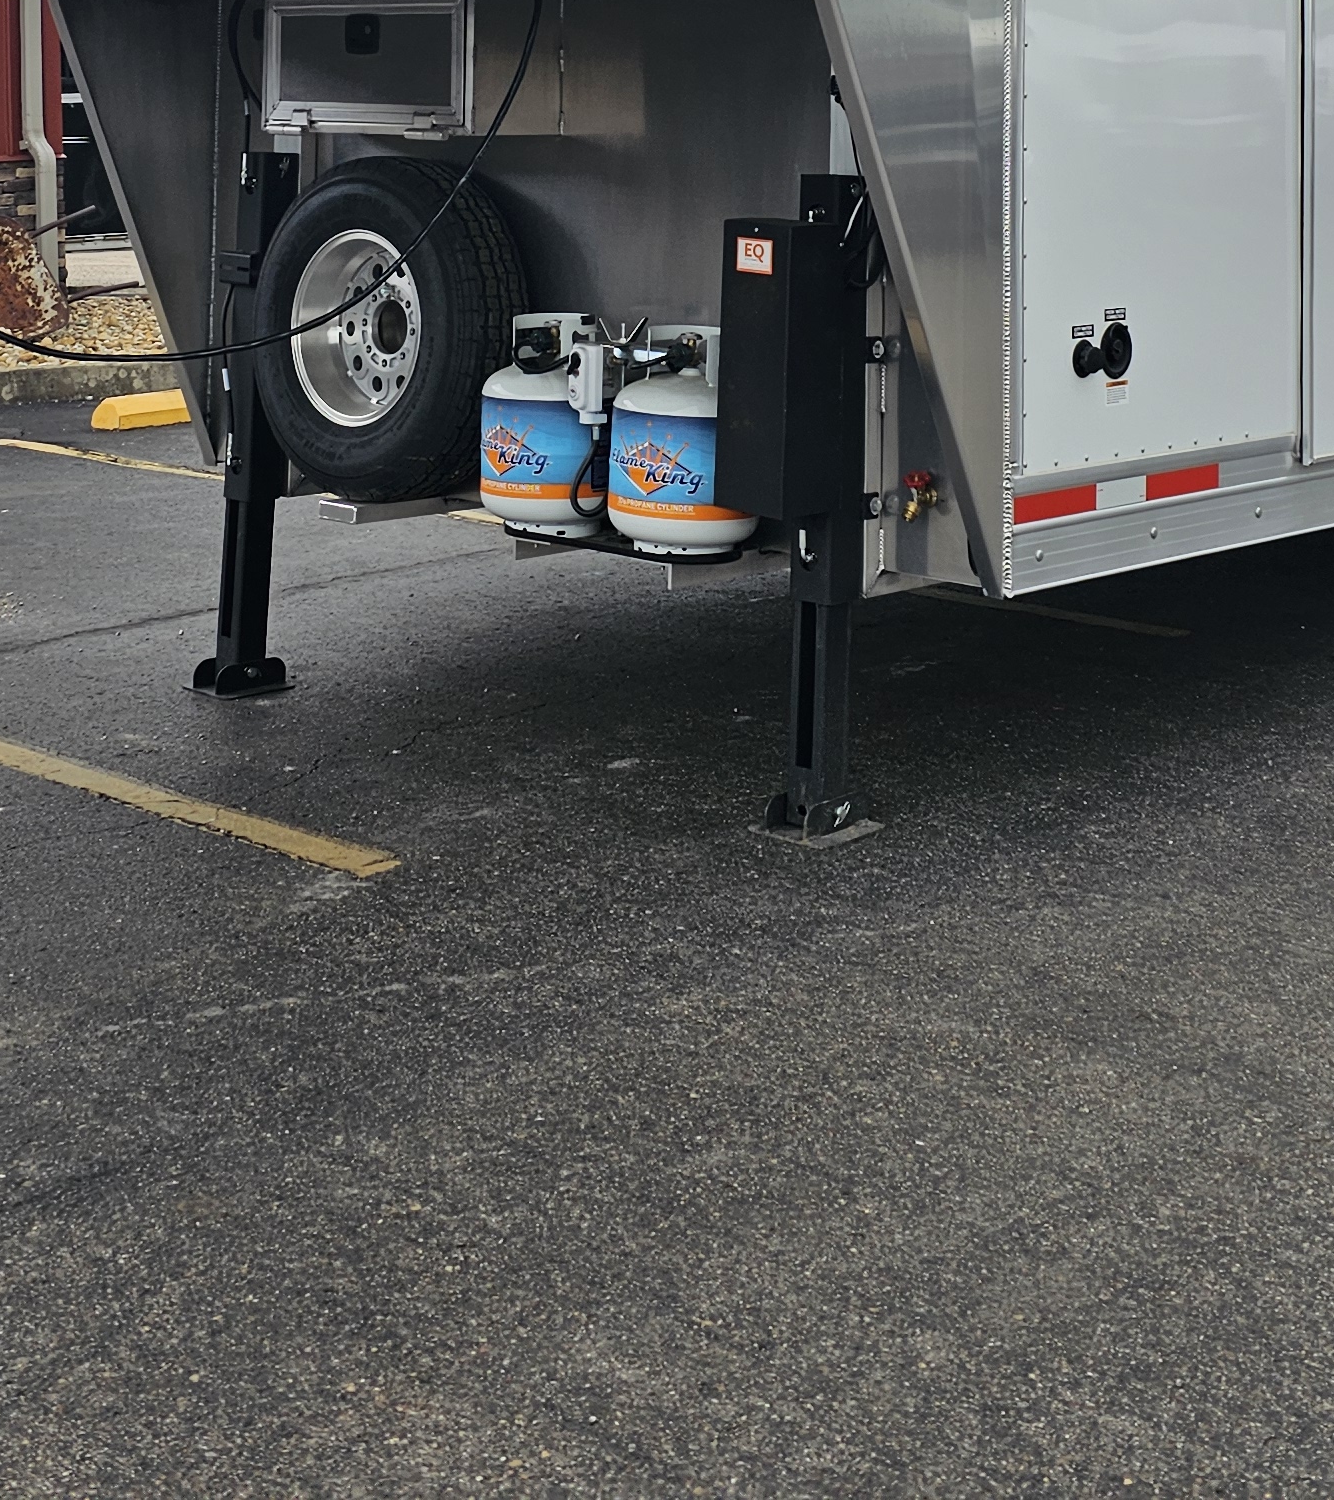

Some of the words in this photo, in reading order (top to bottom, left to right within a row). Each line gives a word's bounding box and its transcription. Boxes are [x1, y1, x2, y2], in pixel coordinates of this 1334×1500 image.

[744, 242, 765, 263] EQ
[497, 444, 549, 475] King
[612, 448, 648, 468] Flame
[645, 463, 703, 495] King
[656, 503, 695, 512] CYLINDER
